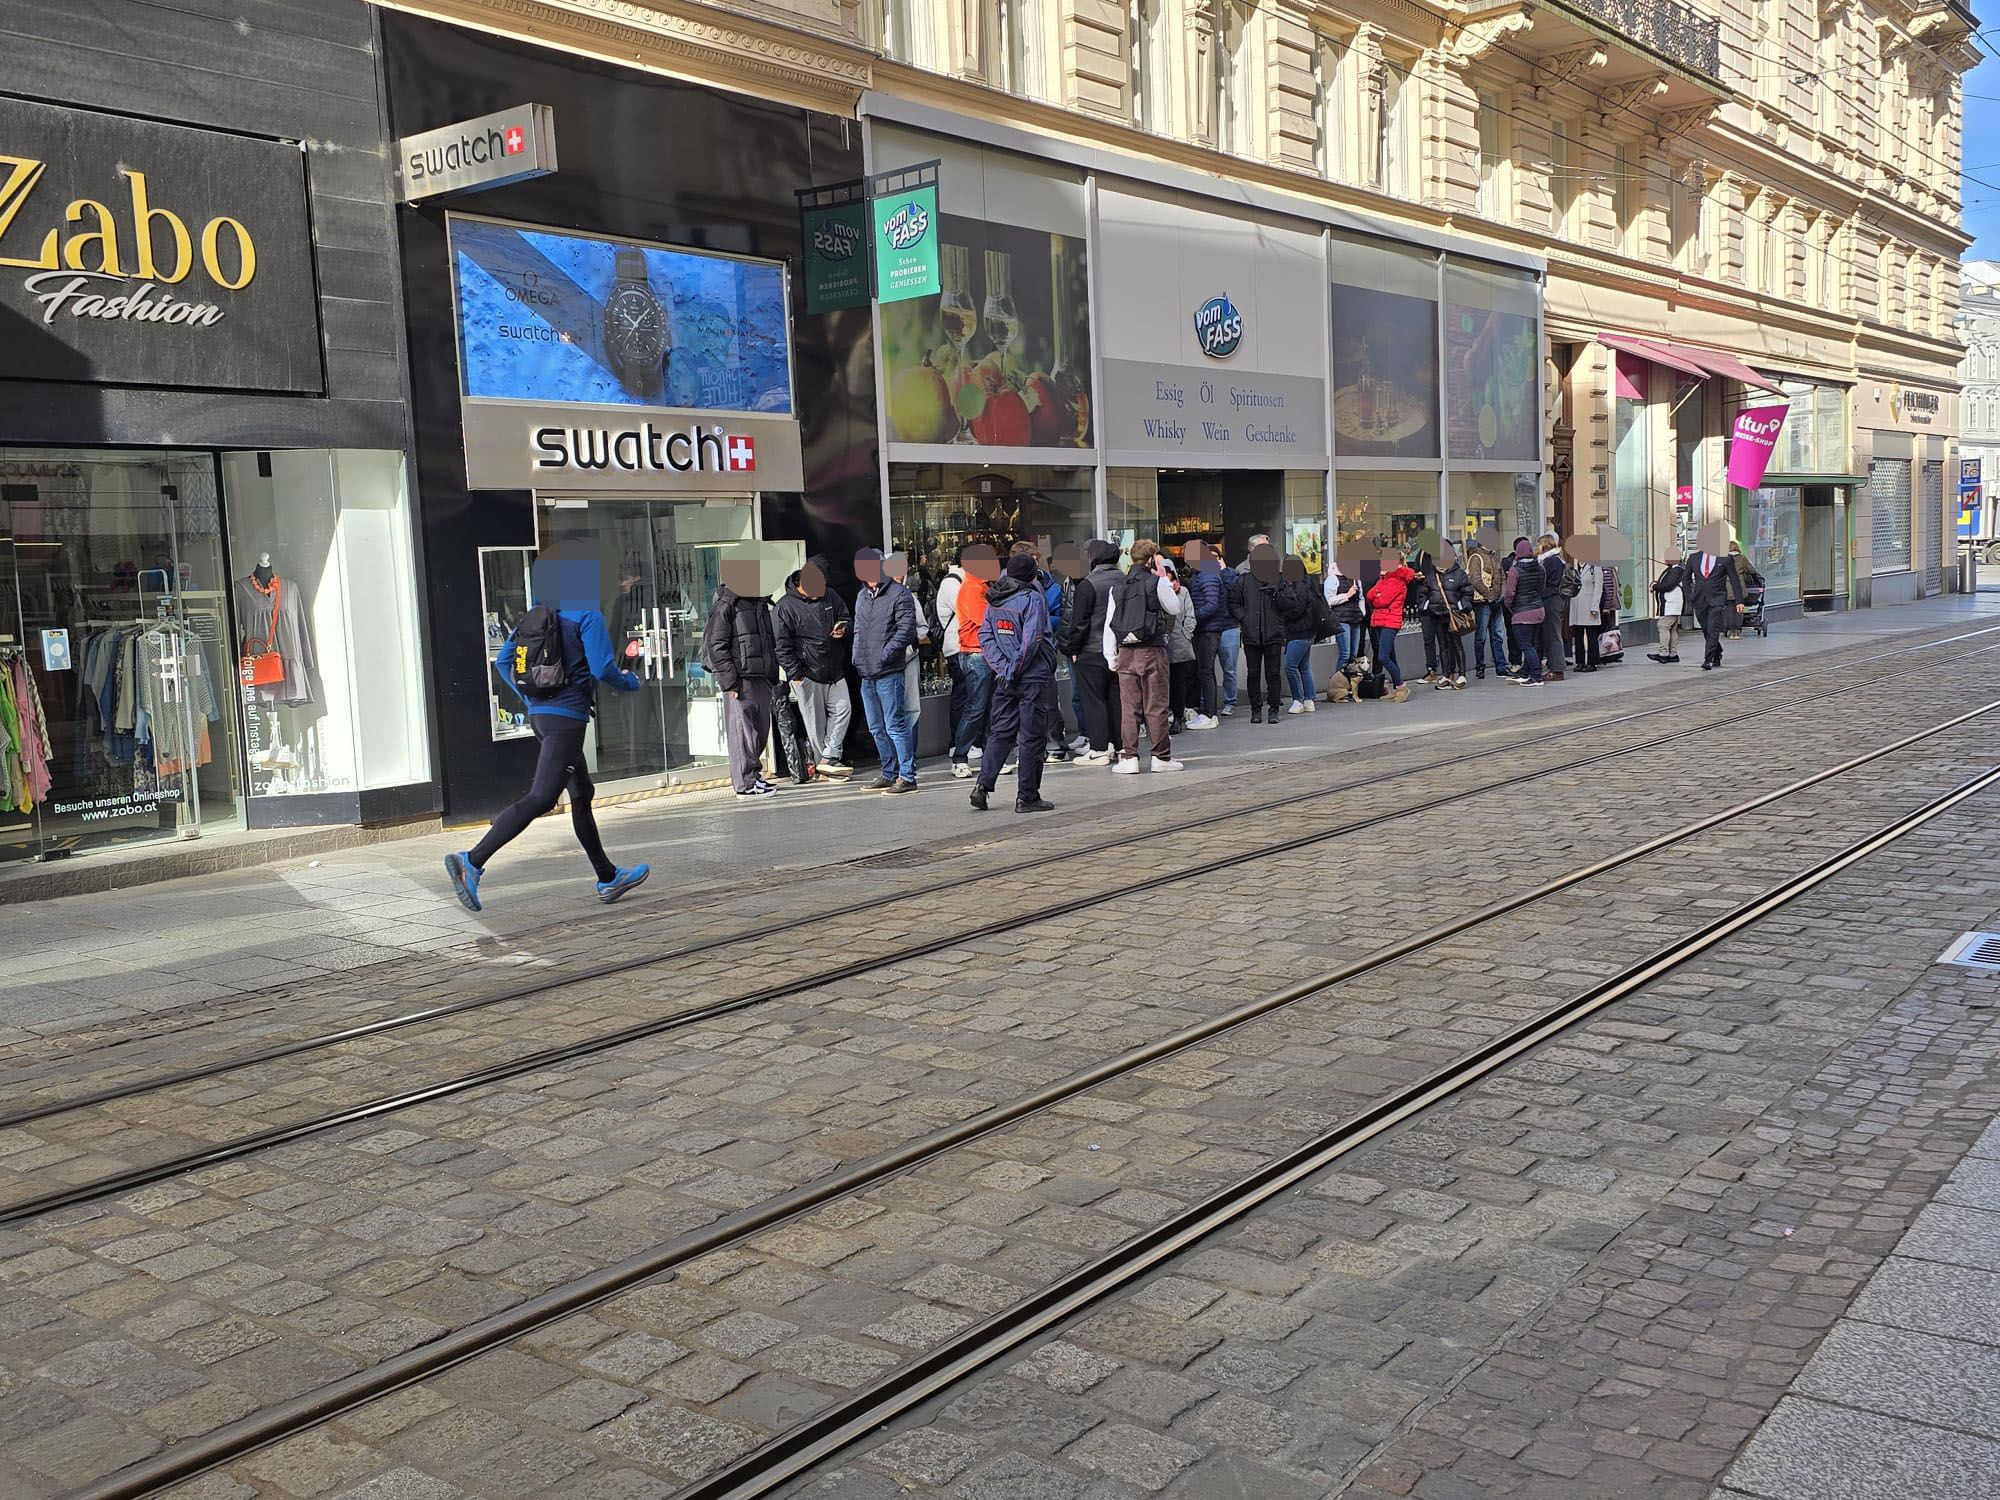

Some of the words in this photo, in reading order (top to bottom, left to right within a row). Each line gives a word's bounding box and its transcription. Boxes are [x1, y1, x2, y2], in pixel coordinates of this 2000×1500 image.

[410, 128, 506, 180] swatch
[0, 155, 256, 290] Zabo
[884, 210, 907, 235] vom
[892, 211, 928, 249] FASS
[890, 265, 926, 278] PROBIEREN
[890, 275, 927, 289] GENIESSEN
[24, 270, 224, 326] Fashion
[505, 287, 560, 306] OMEGA
[1195, 304, 1221, 329] vom
[499, 325, 560, 342] swatch
[1206, 315, 1242, 351] FASS
[1156, 381, 1184, 408] Essig
[1200, 381, 1214, 404] Öl
[1230, 387, 1284, 412] Spirituosen
[1143, 419, 1187, 445] Whisky
[1202, 422, 1230, 441] Wein
[1245, 424, 1296, 443] Geschenke
[533, 422, 724, 472] swatch
[242, 656, 255, 681] folge
[246, 684, 256, 702] uns
[247, 703, 261, 721] auf
[248, 722, 261, 773] Instagm
[54, 800, 93, 814] Besuche
[95, 795, 131, 808] unseren
[133, 788, 180, 802] Onlineshop
[81, 801, 158, 821] www.zabo.at
